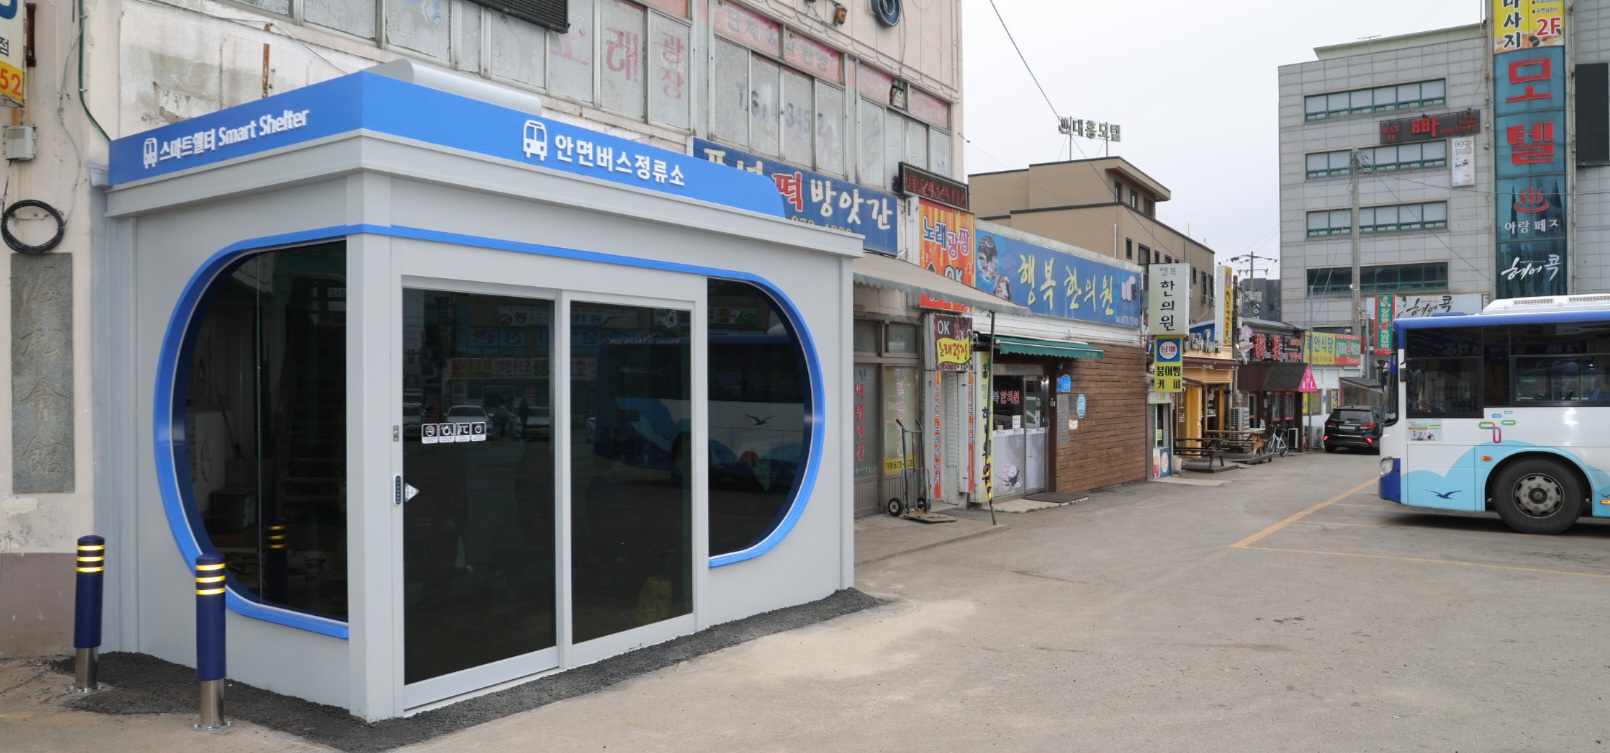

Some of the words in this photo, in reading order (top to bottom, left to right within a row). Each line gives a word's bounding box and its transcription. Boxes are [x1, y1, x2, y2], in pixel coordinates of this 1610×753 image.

[1536, 18, 1561, 36] 2F
[159, 129, 216, 161] 스마트쉘터
[218, 120, 257, 147] Smart
[259, 110, 309, 137] Shelter
[1506, 58, 1554, 165] 모텔
[555, 135, 685, 187] 안면버스정류소
[811, 179, 893, 230] 방앗간
[1018, 254, 1056, 310] 행복
[1064, 266, 1115, 316] 한의원
[1159, 280, 1175, 332] 한의원
[937, 320, 950, 335] OK
[1160, 345, 1177, 353] 담배
[1157, 365, 1181, 377] 붕어빵
[1000, 391, 1020, 404] 한의원
